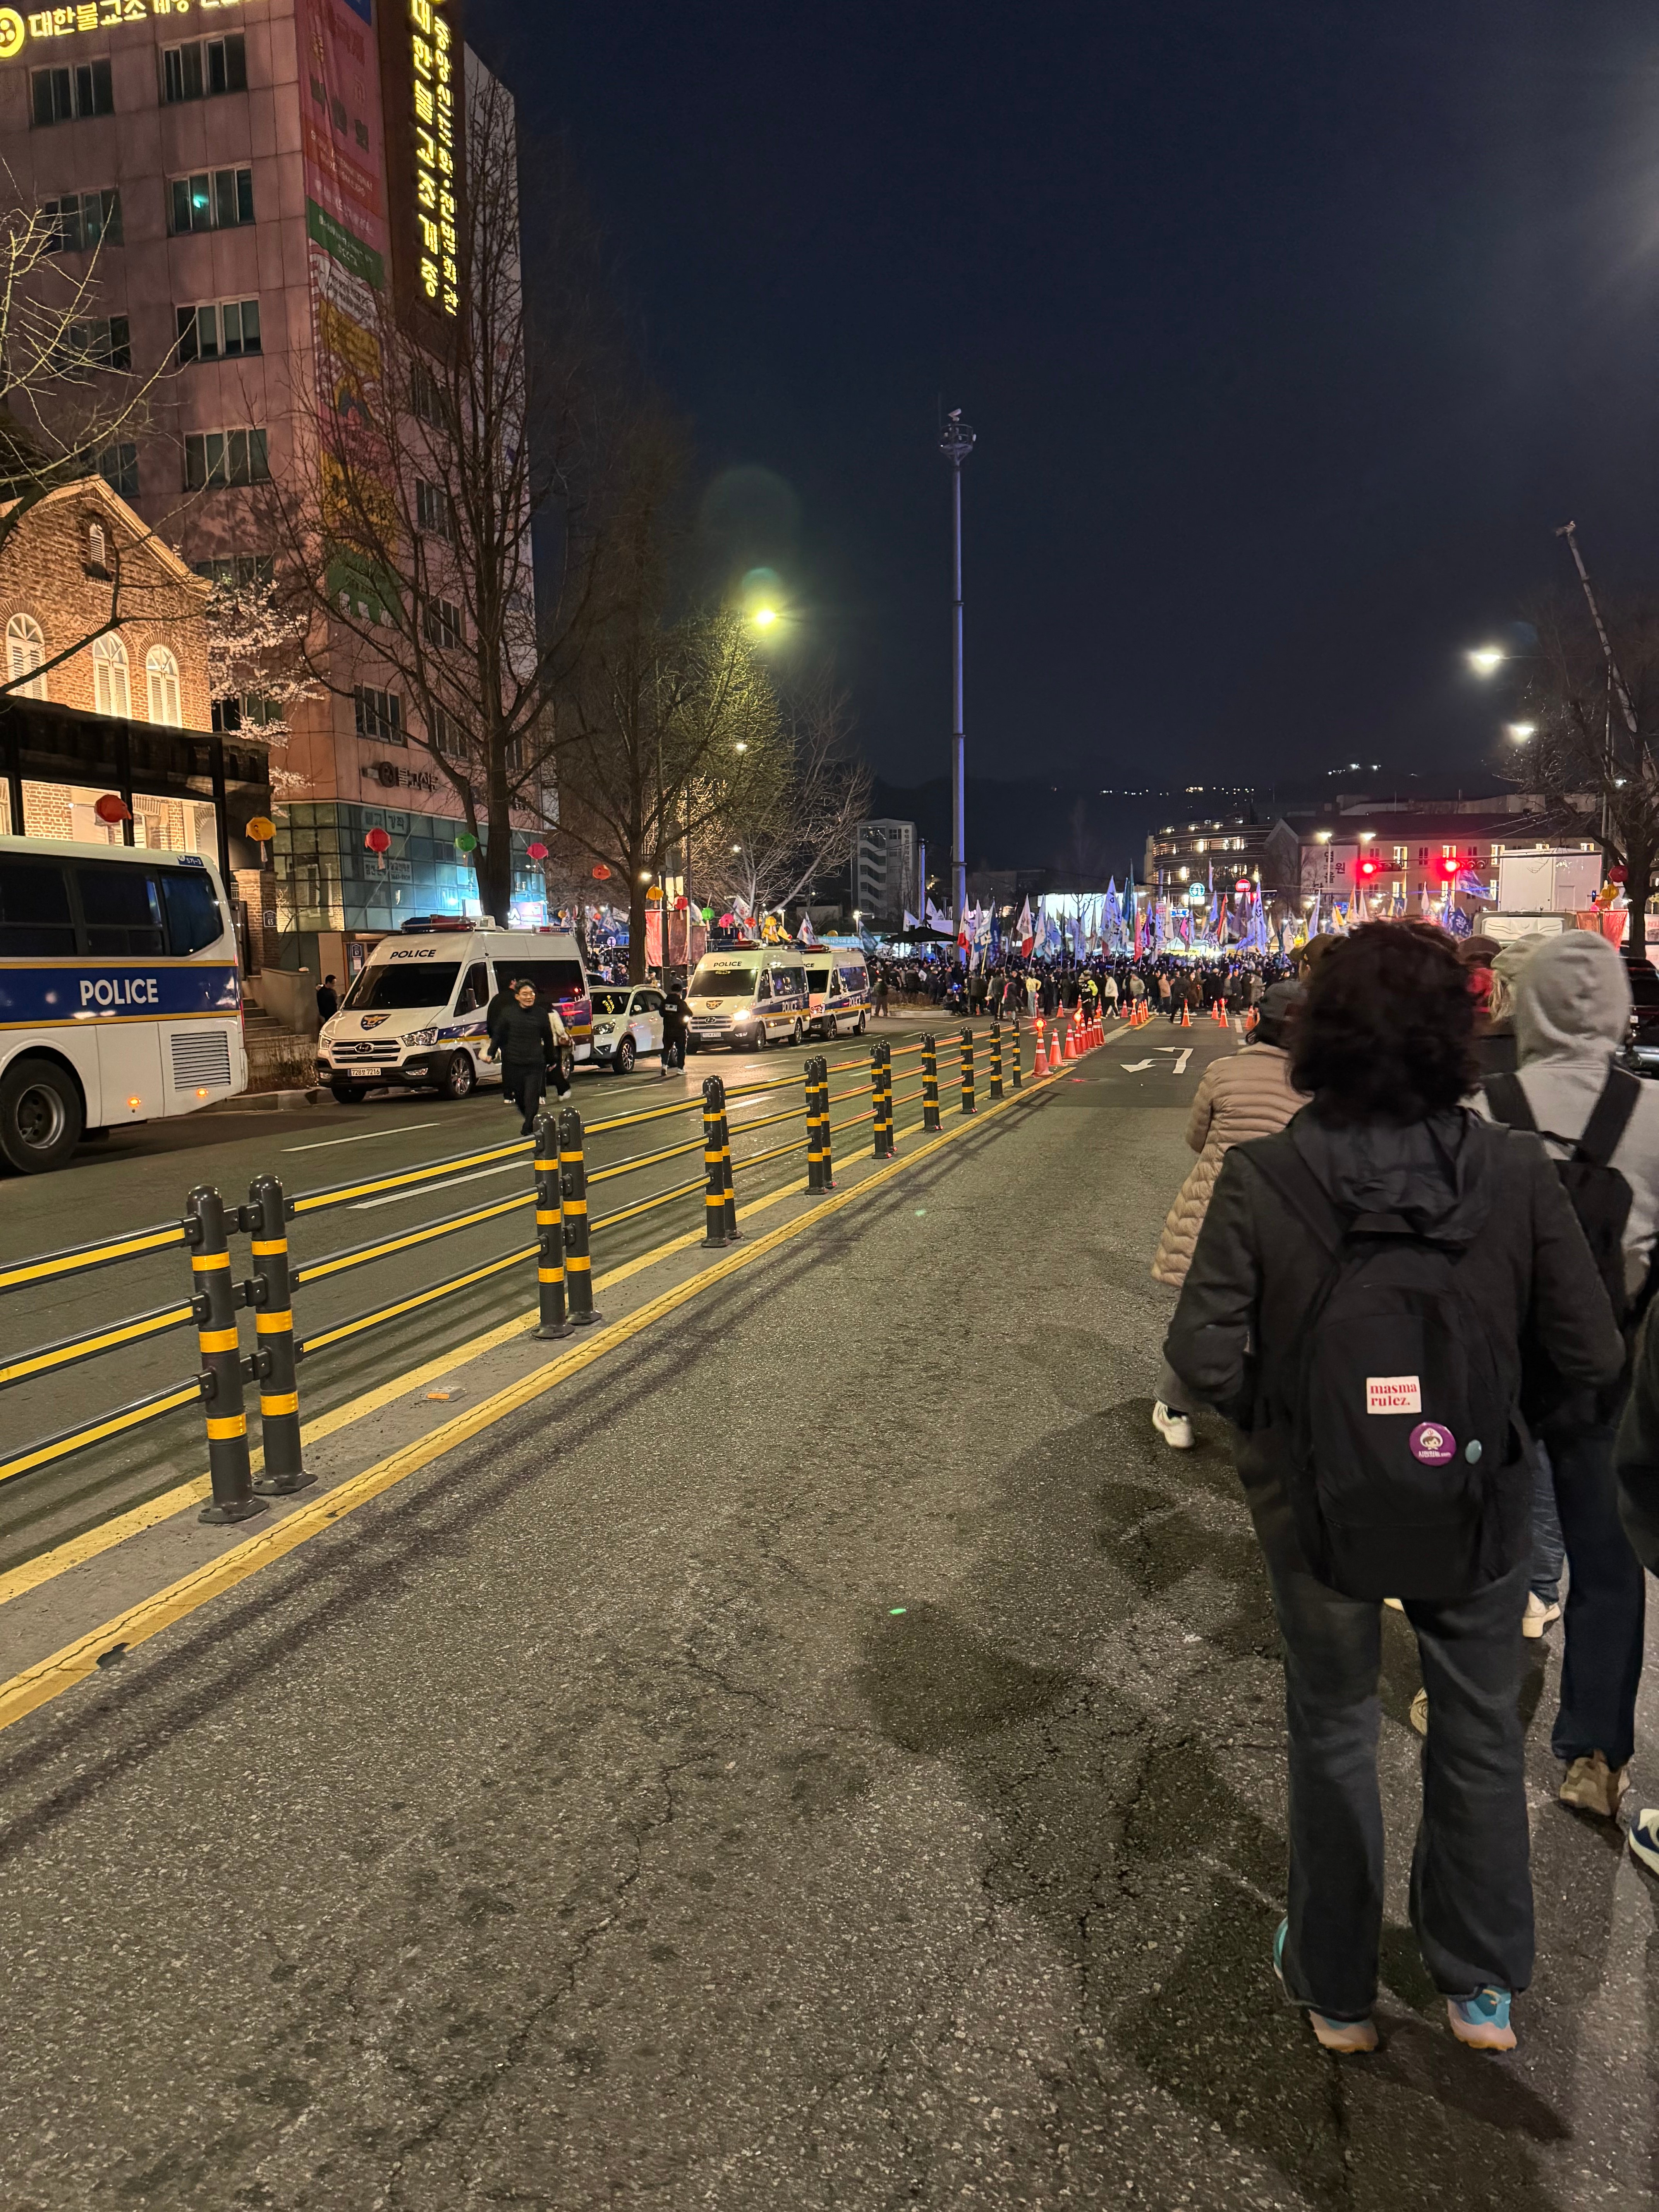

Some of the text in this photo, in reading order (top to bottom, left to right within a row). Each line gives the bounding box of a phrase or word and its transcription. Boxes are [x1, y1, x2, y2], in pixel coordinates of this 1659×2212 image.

[412, 0, 438, 297] 대한불교조계종
[390, 950, 436, 959] POLICE
[80, 979, 159, 1006] POLICE
[782, 1000, 797, 1013] POLICE
[849, 995, 861, 1007] POLICE
[1370, 1384, 1417, 1394] masma
[1371, 1395, 1410, 1407] rulez.
